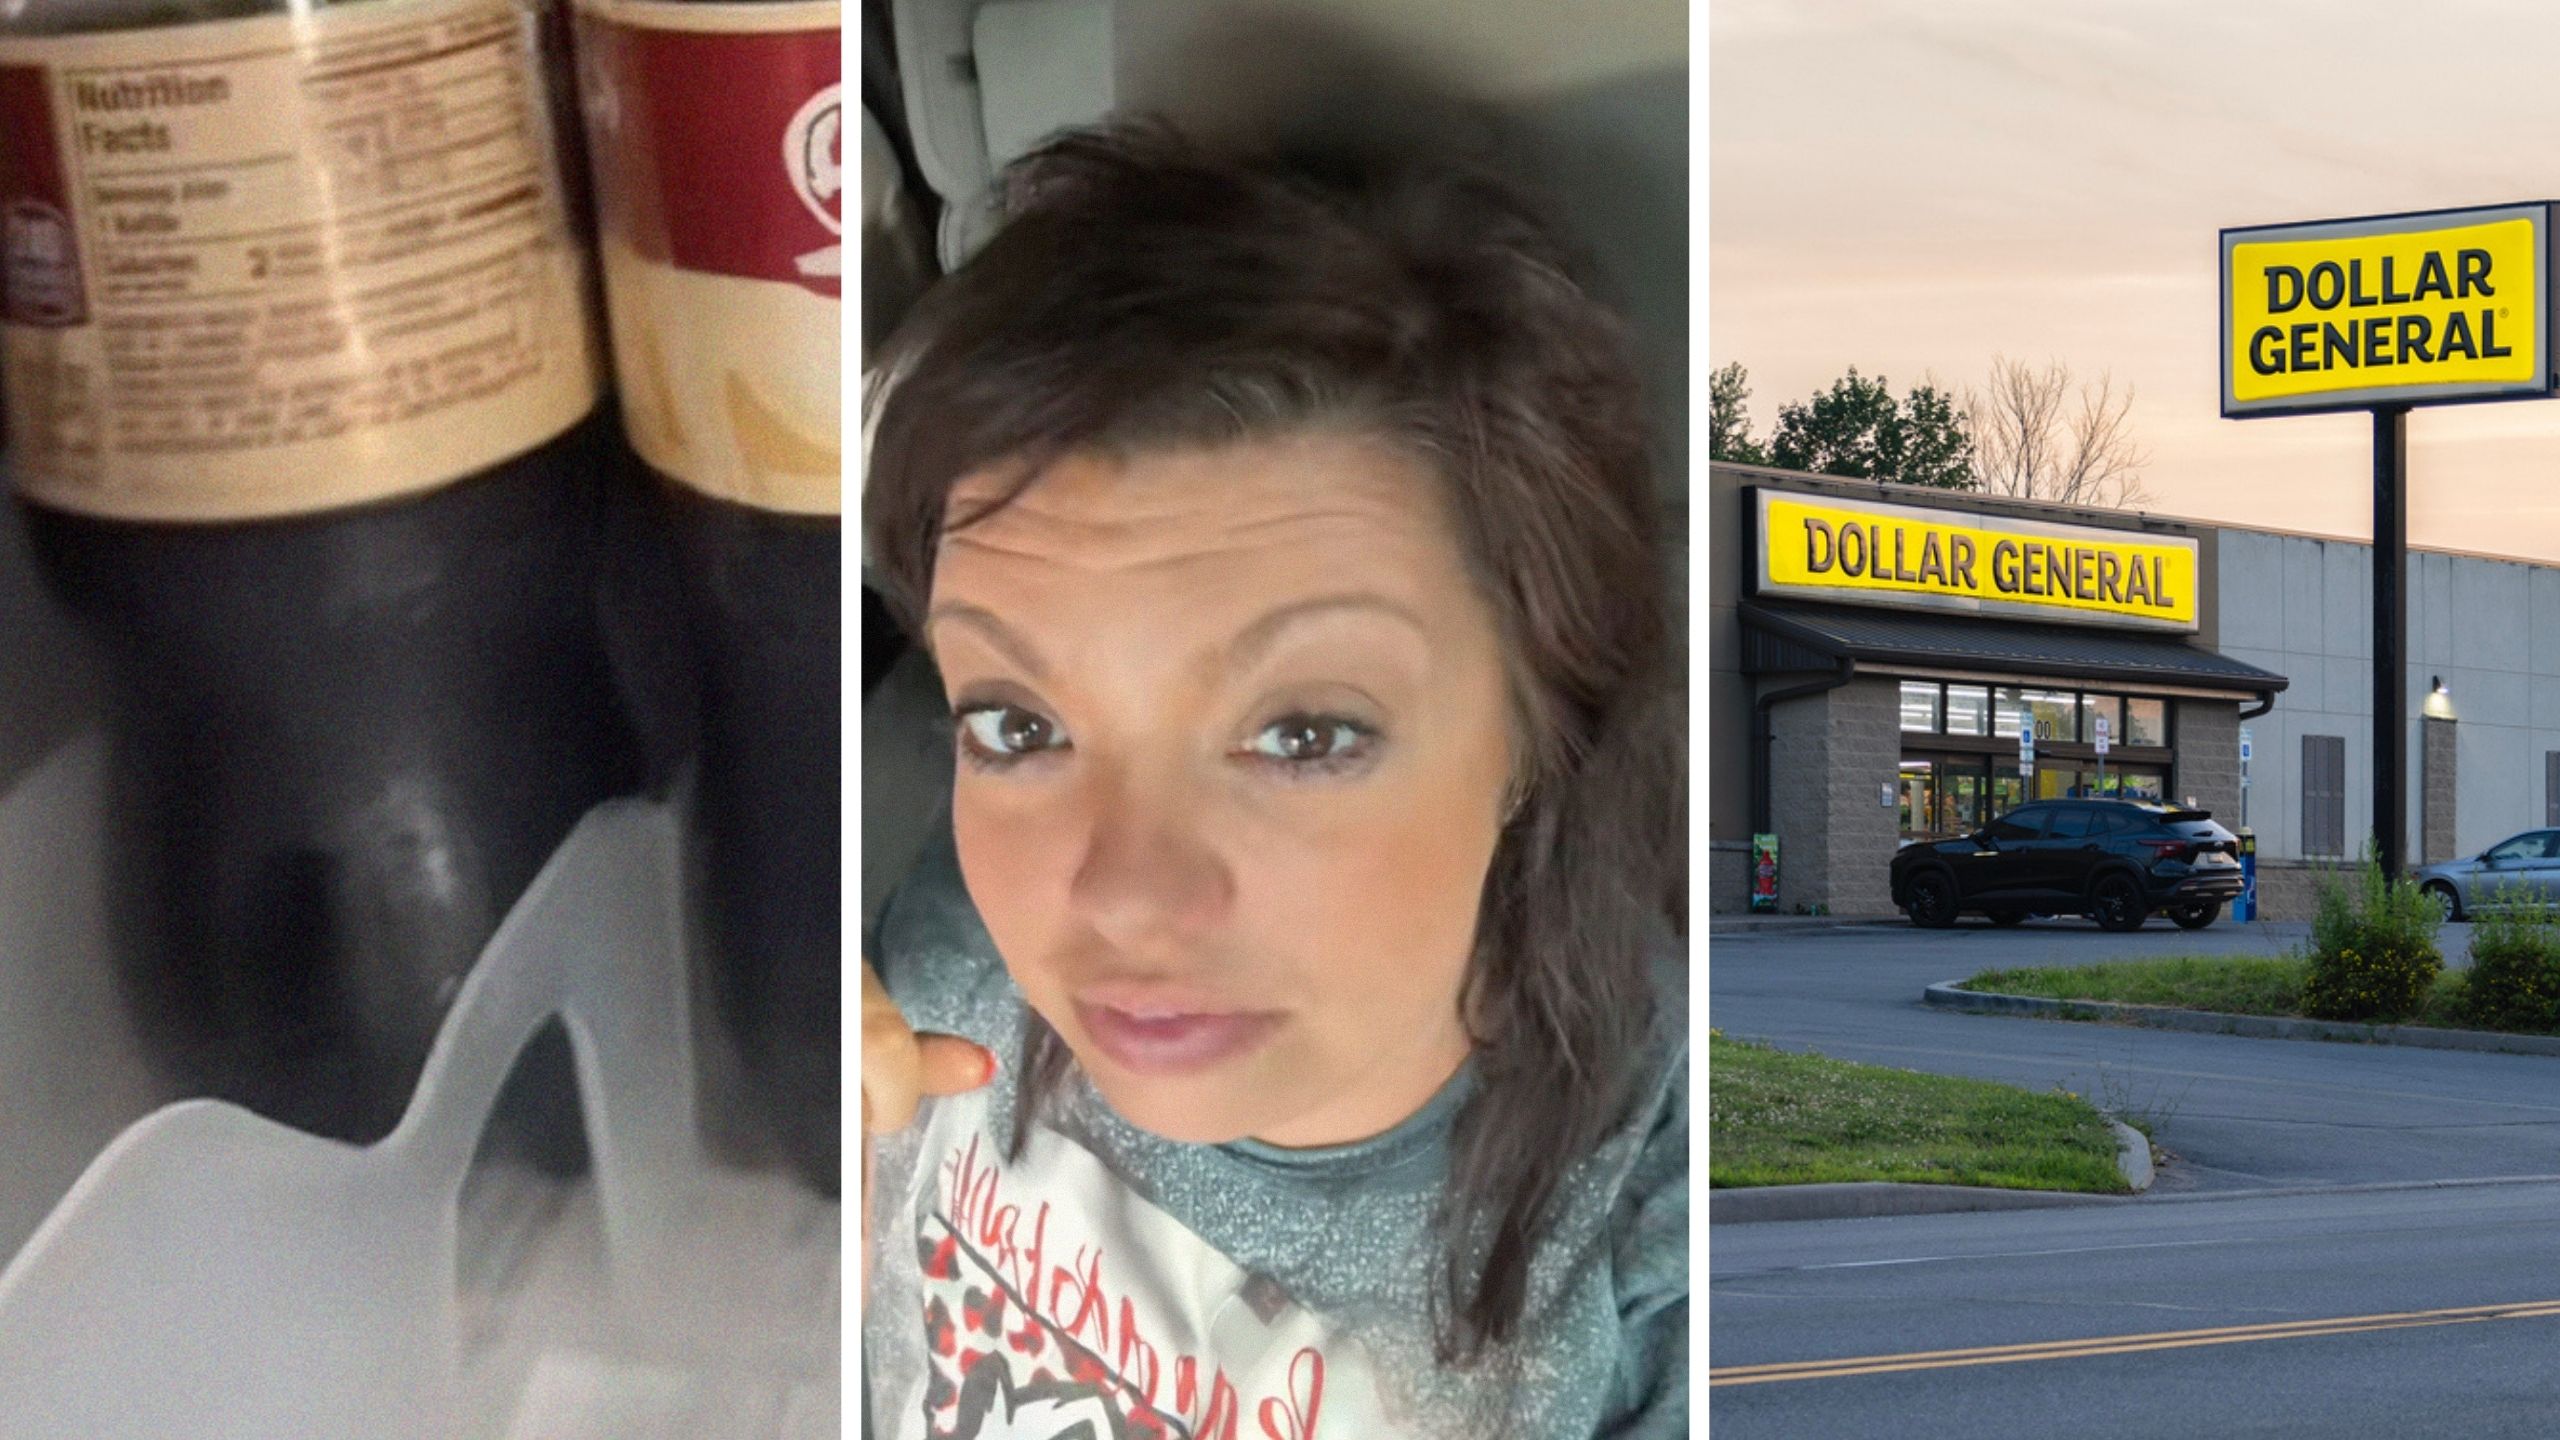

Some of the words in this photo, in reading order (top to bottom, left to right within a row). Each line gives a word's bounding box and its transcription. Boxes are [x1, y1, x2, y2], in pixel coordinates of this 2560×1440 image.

[81, 121, 171, 154] Facts
[2264, 248, 2495, 314] DOLLAR
[2249, 309, 2512, 376] GENERAL
[1804, 518, 1979, 589] DOLLAR
[1992, 539, 2175, 608] GENERAL
